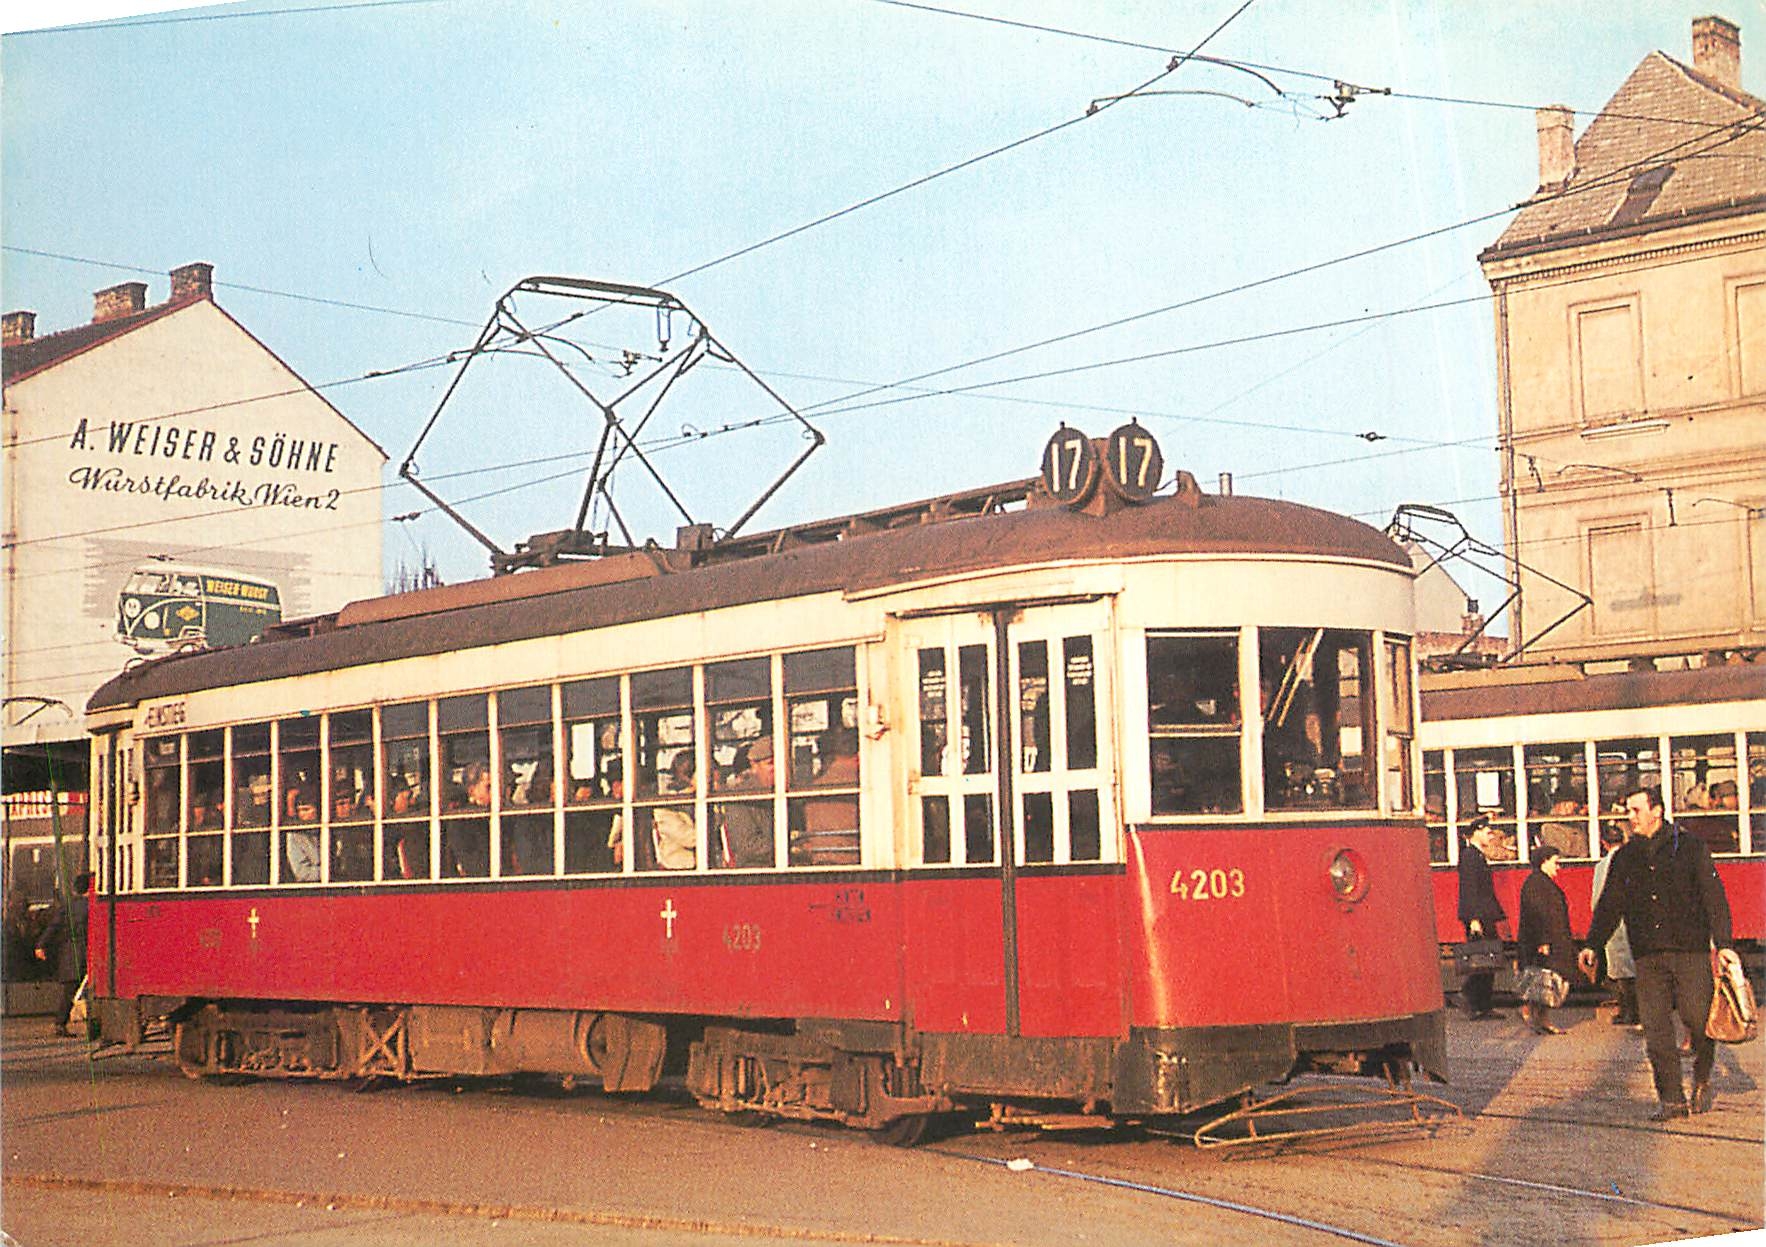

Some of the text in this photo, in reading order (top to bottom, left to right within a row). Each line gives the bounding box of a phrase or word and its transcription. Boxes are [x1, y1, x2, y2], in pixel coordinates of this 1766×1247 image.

[69, 418, 340, 474] A. WEISER & SÖHNE
[1051, 438, 1083, 493] 17
[1118, 436, 1153, 488] 17
[253, 482, 322, 509] Wien
[325, 488, 341, 512] 2
[1170, 868, 1246, 901] 4203
[722, 922, 762, 953] 4203
